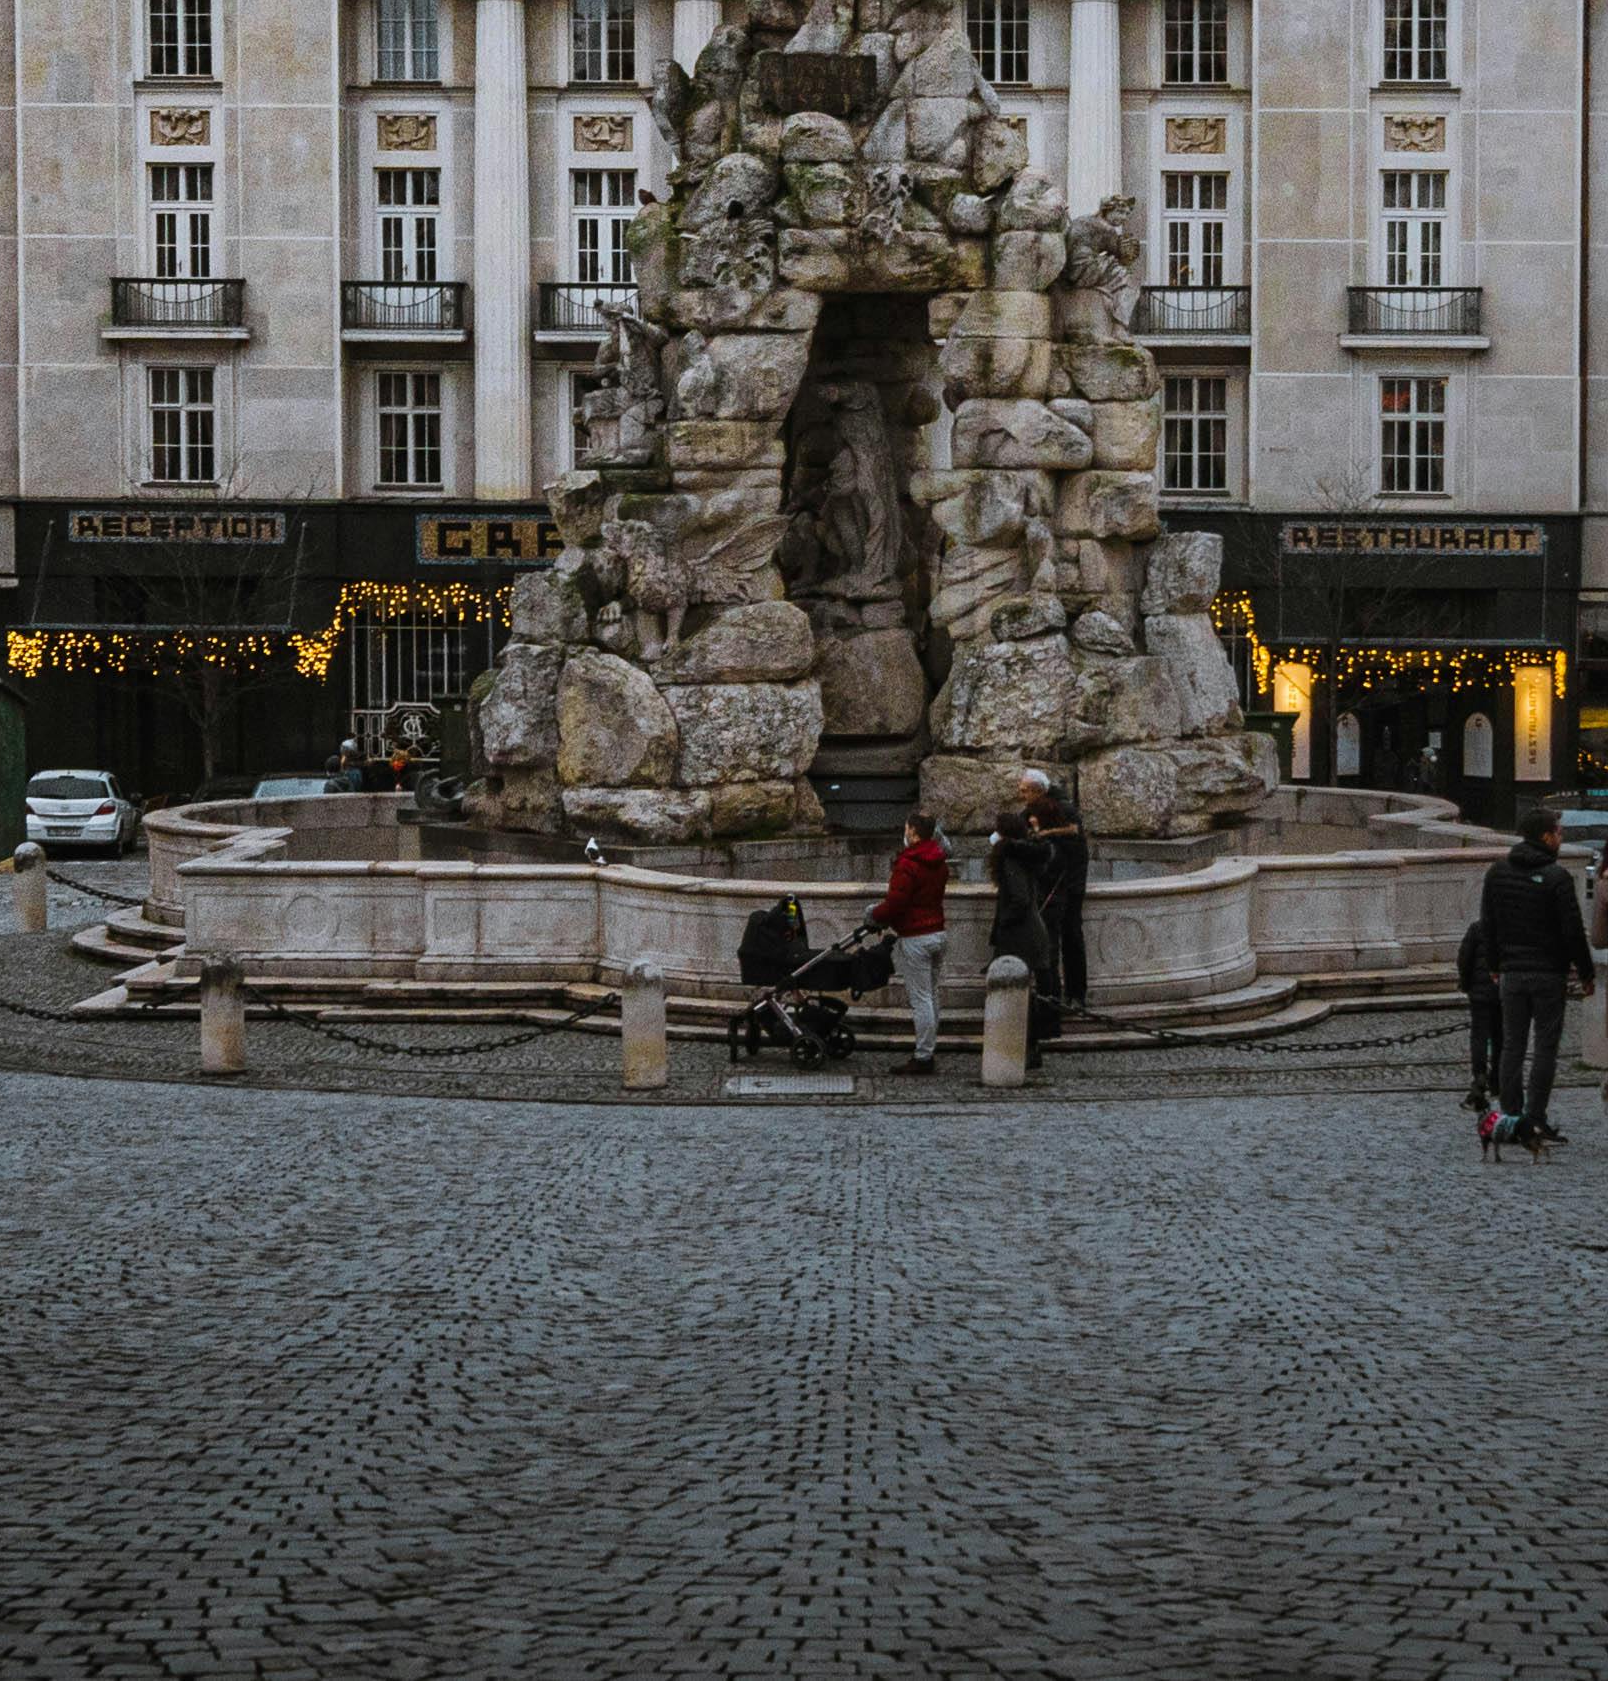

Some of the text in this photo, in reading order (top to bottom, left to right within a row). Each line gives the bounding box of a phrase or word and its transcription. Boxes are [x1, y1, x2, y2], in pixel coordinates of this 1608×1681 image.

[77, 516, 276, 537] RECEPTION
[1292, 527, 1534, 549] RESTAURANT
[1528, 684, 1537, 764] RESTAURANT
